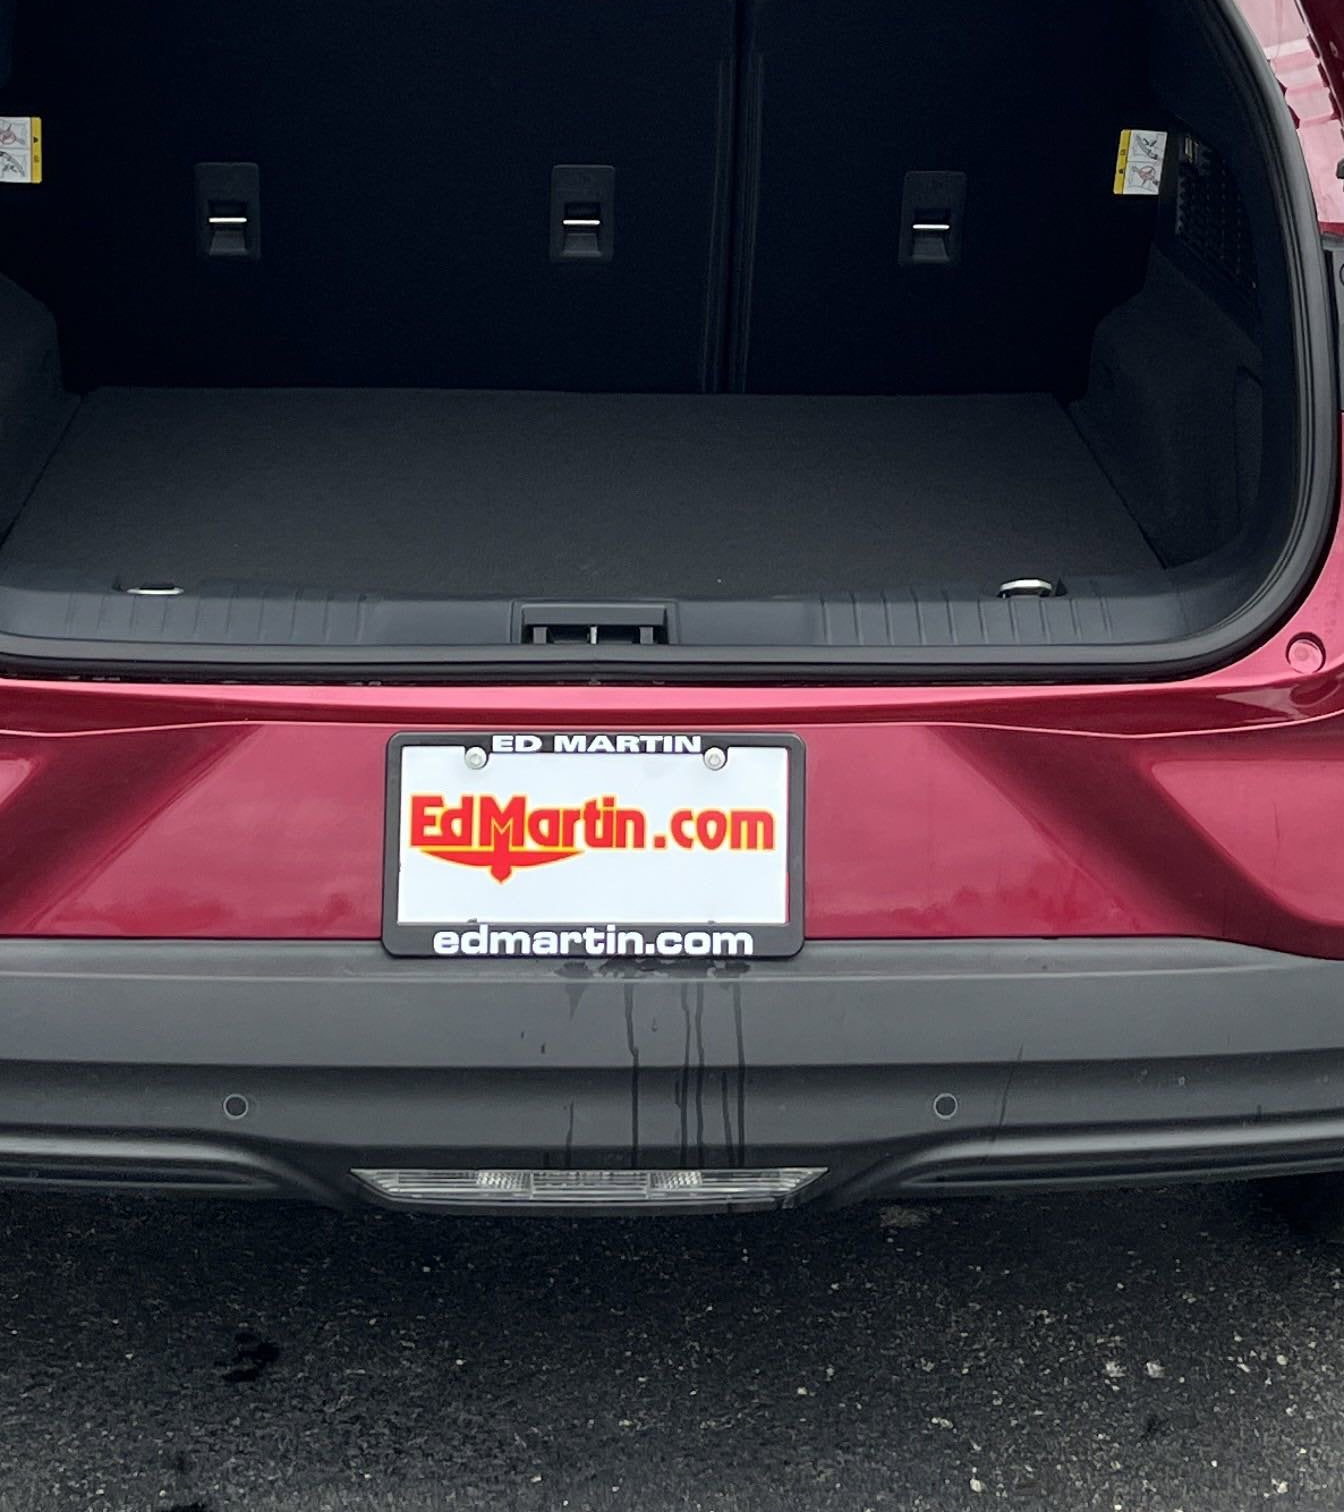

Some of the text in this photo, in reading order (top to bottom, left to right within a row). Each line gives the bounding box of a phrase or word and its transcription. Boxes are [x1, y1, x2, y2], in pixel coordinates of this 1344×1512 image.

[492, 735, 702, 753] ED MARTIN
[433, 924, 754, 956] edmartin.com
